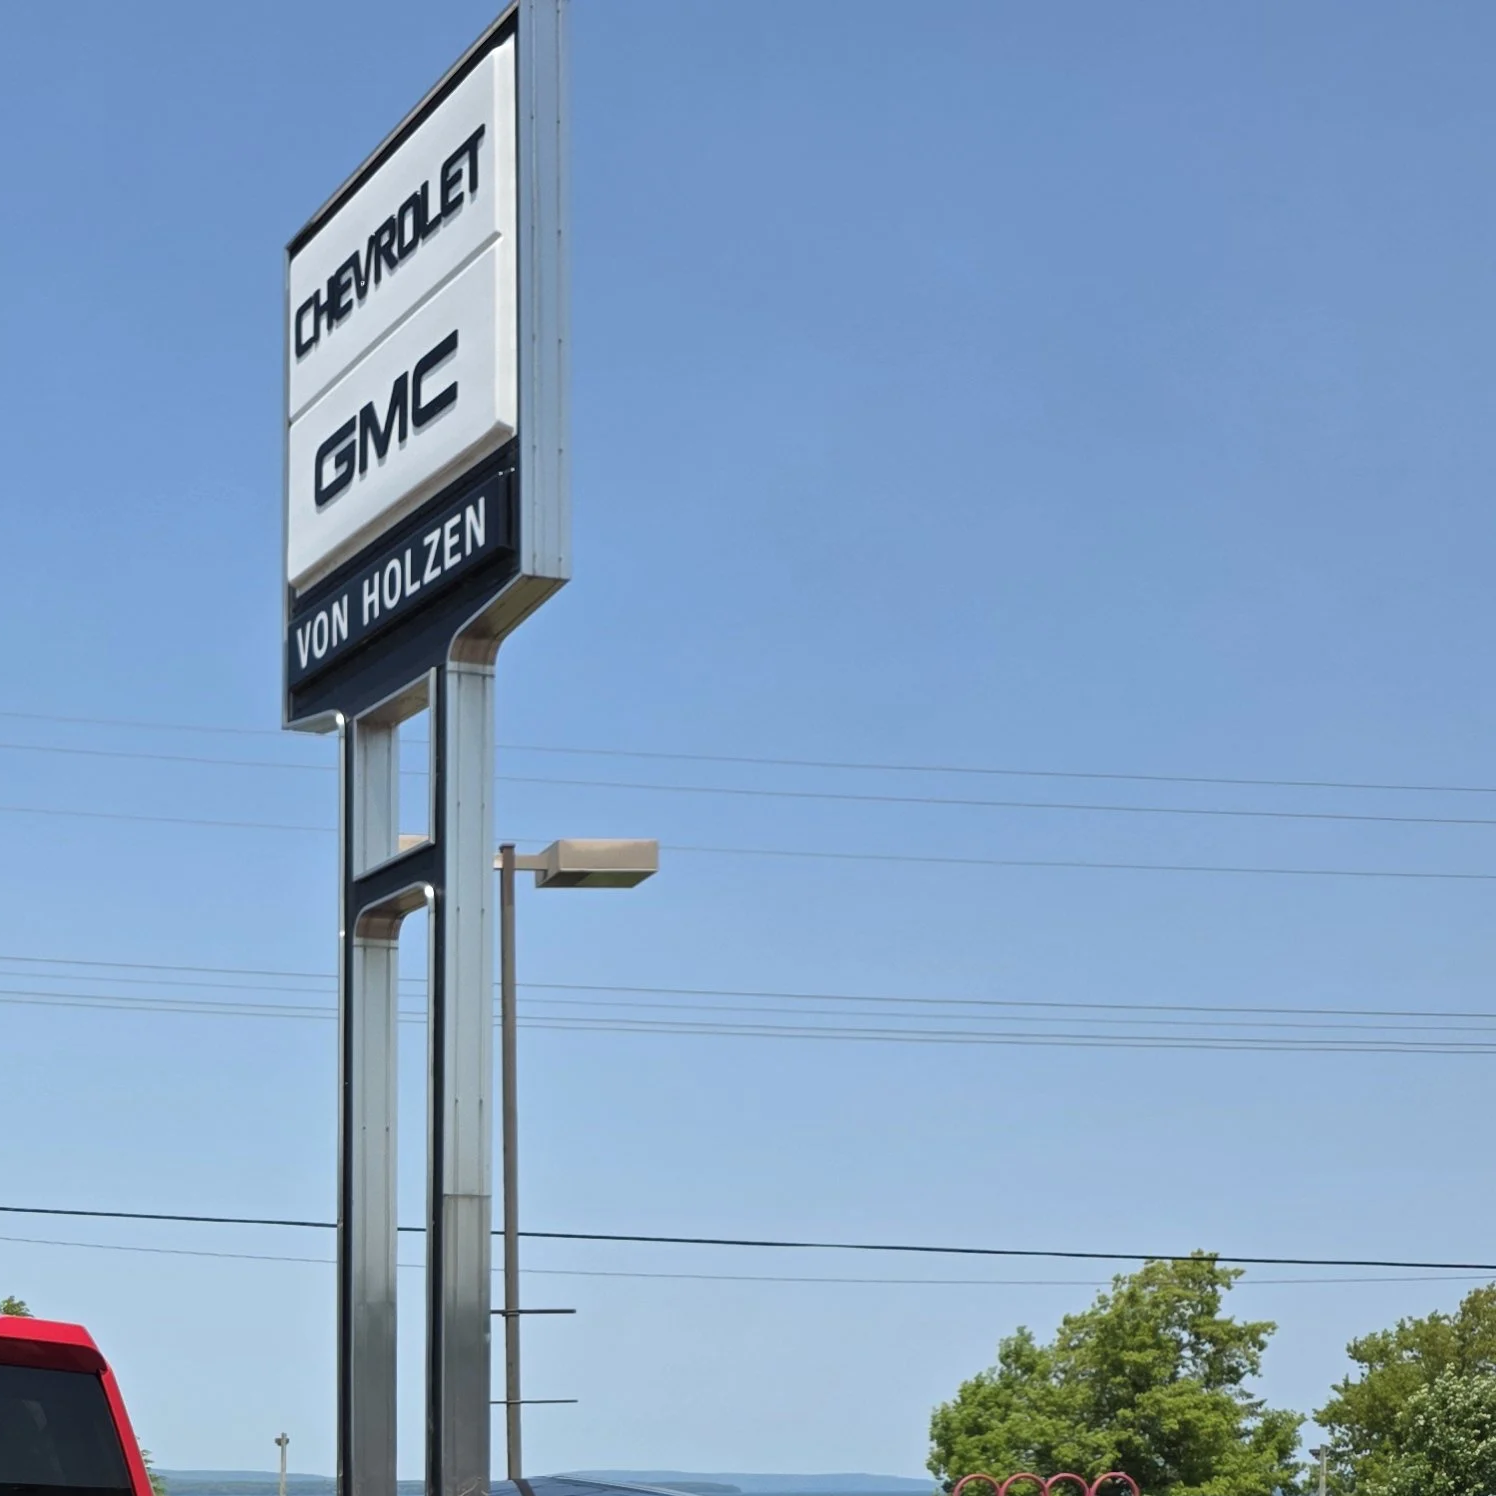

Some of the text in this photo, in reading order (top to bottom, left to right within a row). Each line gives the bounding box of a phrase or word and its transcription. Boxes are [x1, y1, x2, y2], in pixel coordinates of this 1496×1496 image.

[294, 123, 486, 359] CHEVROLET
[314, 329, 458, 506] GMC
[297, 497, 486, 669] VON HOLZEN
